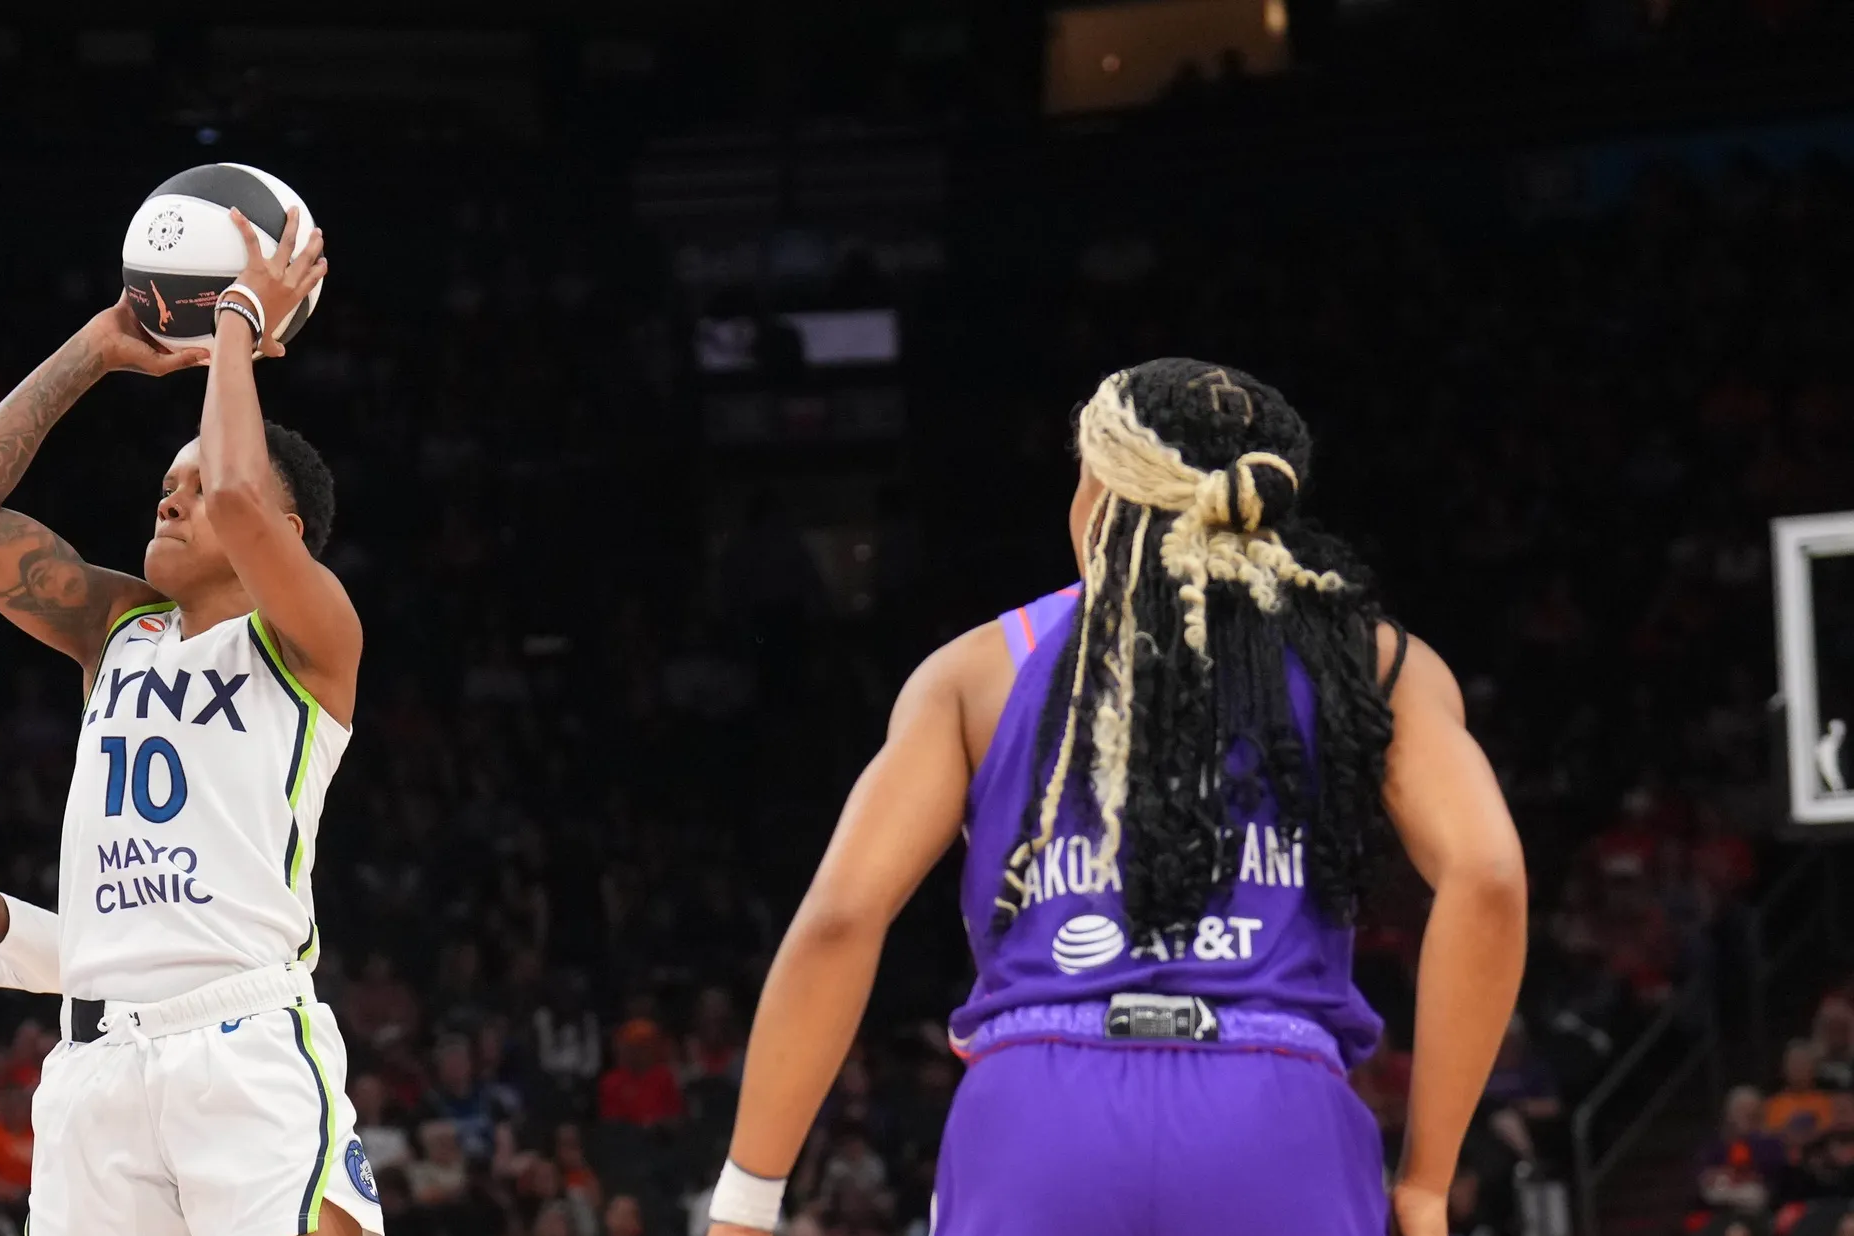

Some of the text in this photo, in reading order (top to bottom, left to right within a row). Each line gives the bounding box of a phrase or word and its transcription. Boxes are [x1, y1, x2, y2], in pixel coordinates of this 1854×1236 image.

[99, 735, 188, 824] 10
[97, 837, 197, 874] MAYO
[95, 874, 213, 914] CLINIC
